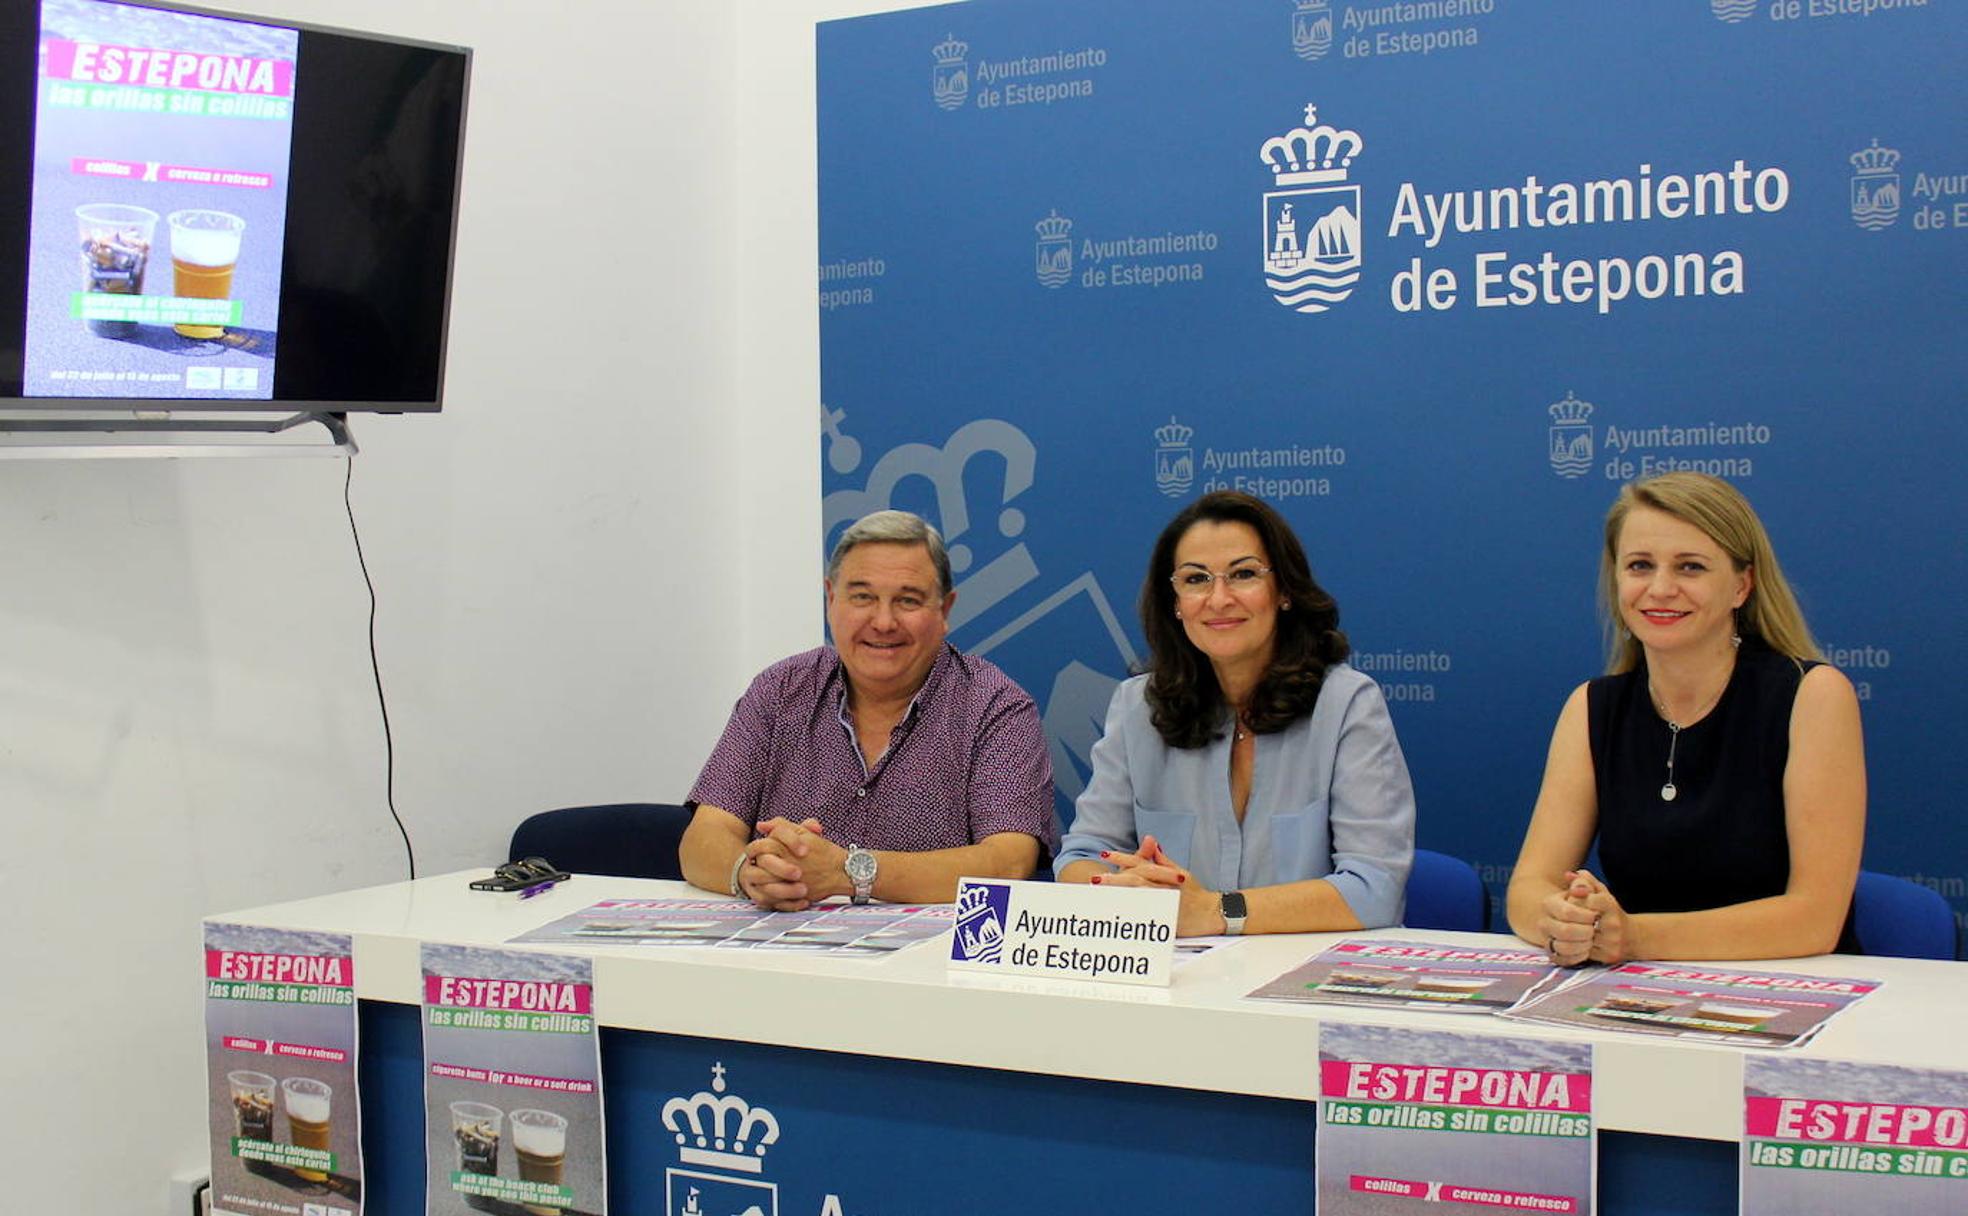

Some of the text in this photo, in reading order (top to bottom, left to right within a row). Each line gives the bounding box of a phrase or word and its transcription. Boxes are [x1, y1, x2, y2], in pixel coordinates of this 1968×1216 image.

[1343, 0, 1494, 32] Ayuntamiento
[1770, 0, 1800, 20] de
[1343, 27, 1478, 58] de Estepona
[70, 43, 275, 93] ESTEPONA
[976, 47, 1107, 83] Ayuntamiento
[91, 88, 164, 112] orillas
[171, 92, 204, 113] sin
[209, 95, 288, 118] colillas
[977, 76, 1093, 109] de Estepona
[1388, 159, 1790, 249] Ayuntamiento
[1913, 206, 1946, 230] de
[1080, 229, 1218, 261] Ayuntamiento
[1081, 262, 1203, 289] de Estepona
[1390, 249, 1745, 315] de Estepona
[1604, 421, 1771, 454] Ayuntamiento
[1203, 444, 1345, 473] Ayuntamiento
[1605, 457, 1634, 480] de
[1235, 476, 1330, 501] Estepona
[1015, 910, 1170, 942] Ayuntamiento
[220, 952, 342, 984] ESTEPONA
[1012, 943, 1150, 977] de Estepona
[208, 982, 353, 1004] las orillas sin colillas
[439, 978, 576, 1012] ESTEPONA
[430, 1009, 590, 1033] las orillas sin colillas
[264, 1040, 275, 1055] X
[513, 1074, 533, 1086] beer
[534, 1078, 543, 1087] or
[568, 1081, 592, 1093] drink
[1346, 1063, 1571, 1108] ESTEPONA
[1326, 1103, 1589, 1137] las orillas sin colillas
[1776, 1099, 1968, 1147] ESTEPO
[1751, 1142, 1968, 1176] las orillas sin c
[1364, 1178, 1570, 1211] colillas X cerveza o refresco
